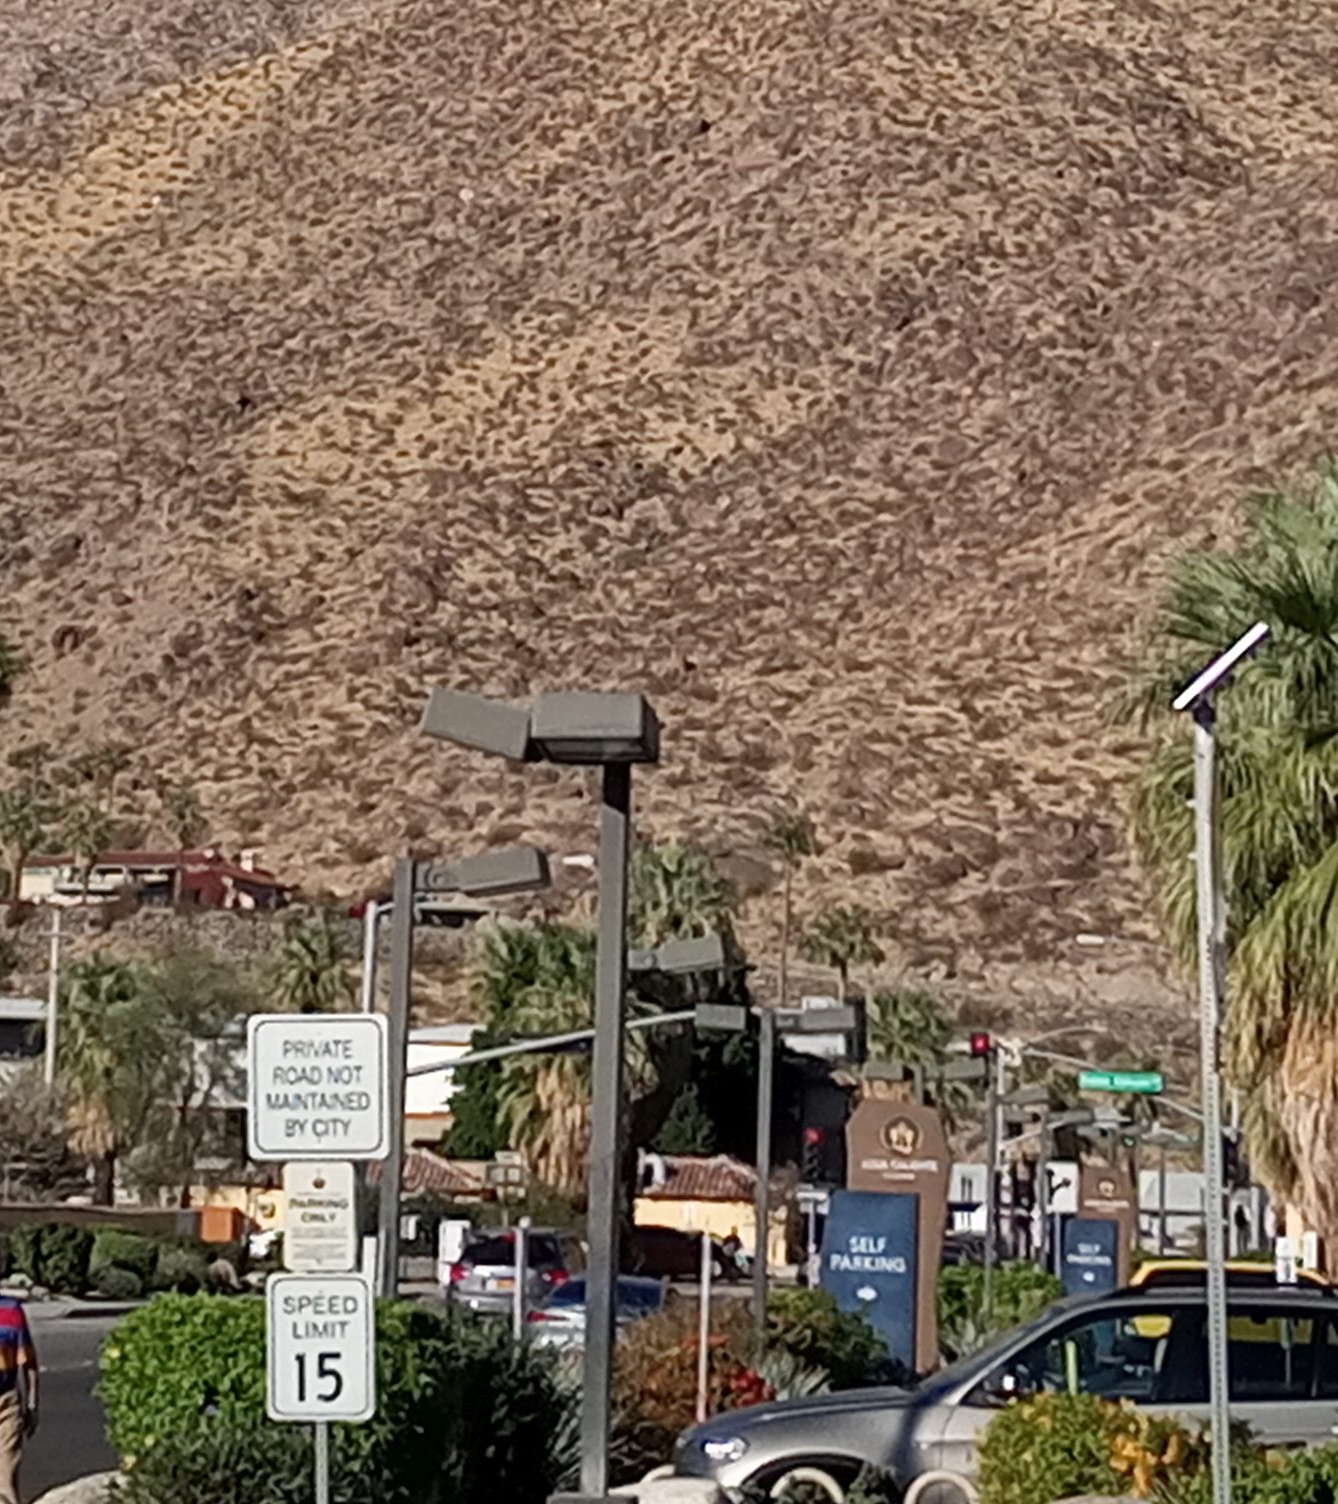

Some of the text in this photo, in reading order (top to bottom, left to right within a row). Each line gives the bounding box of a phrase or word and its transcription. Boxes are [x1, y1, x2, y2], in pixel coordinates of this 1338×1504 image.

[282, 1039, 353, 1059] PRIVATE
[272, 1065, 363, 1085] ROAD NOT
[265, 1091, 371, 1111] MAINTAINED
[285, 1118, 352, 1137] BY CITY
[288, 1198, 350, 1210] PARKING
[300, 1211, 338, 1224] ONLY
[848, 1235, 888, 1254] SELF
[829, 1253, 907, 1274] PARKING
[282, 1295, 359, 1315] SPEED
[292, 1321, 351, 1339] LIMIT
[295, 1351, 344, 1404] 15
